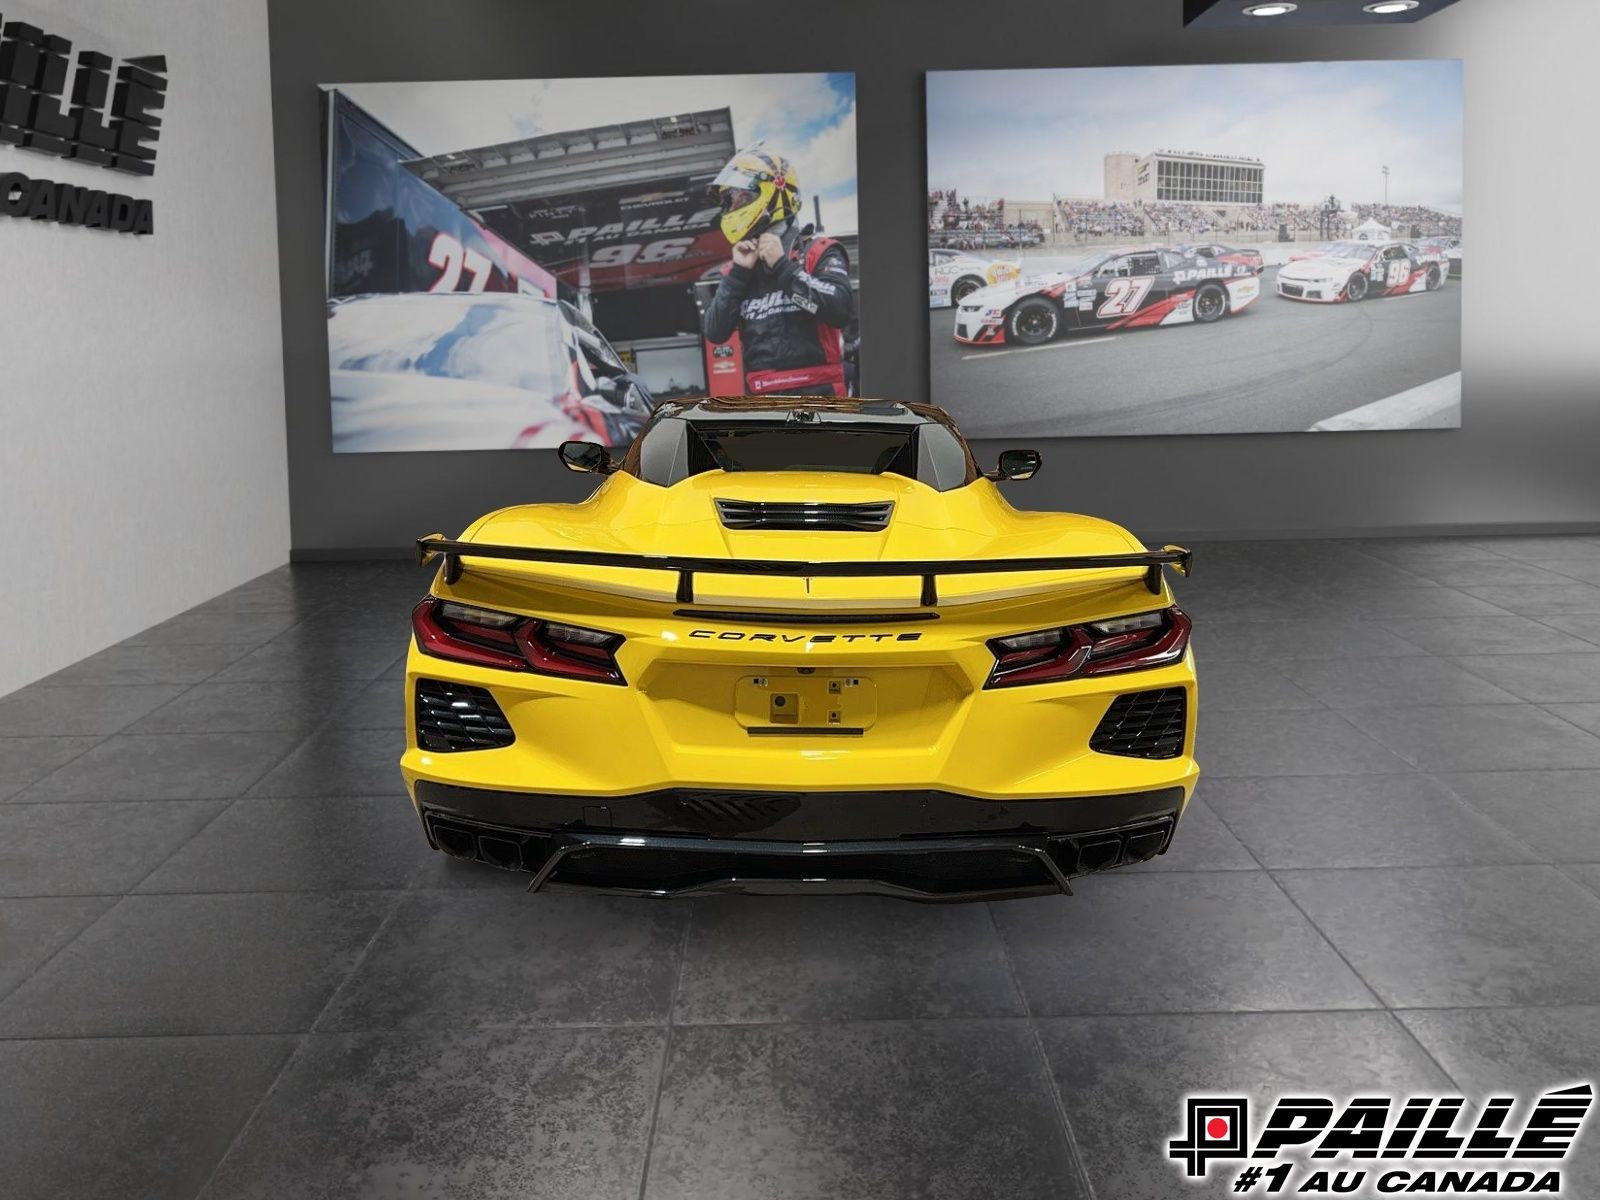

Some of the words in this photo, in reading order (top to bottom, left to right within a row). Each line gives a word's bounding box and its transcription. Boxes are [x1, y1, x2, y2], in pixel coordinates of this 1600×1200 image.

[0, 16, 168, 176] ILLÉ
[0, 172, 154, 235] CANADA
[428, 231, 493, 294] 27
[589, 237, 696, 268] 96
[1386, 258, 1412, 287] 96
[1096, 275, 1156, 319] 27
[689, 629, 923, 643] CORVETTE
